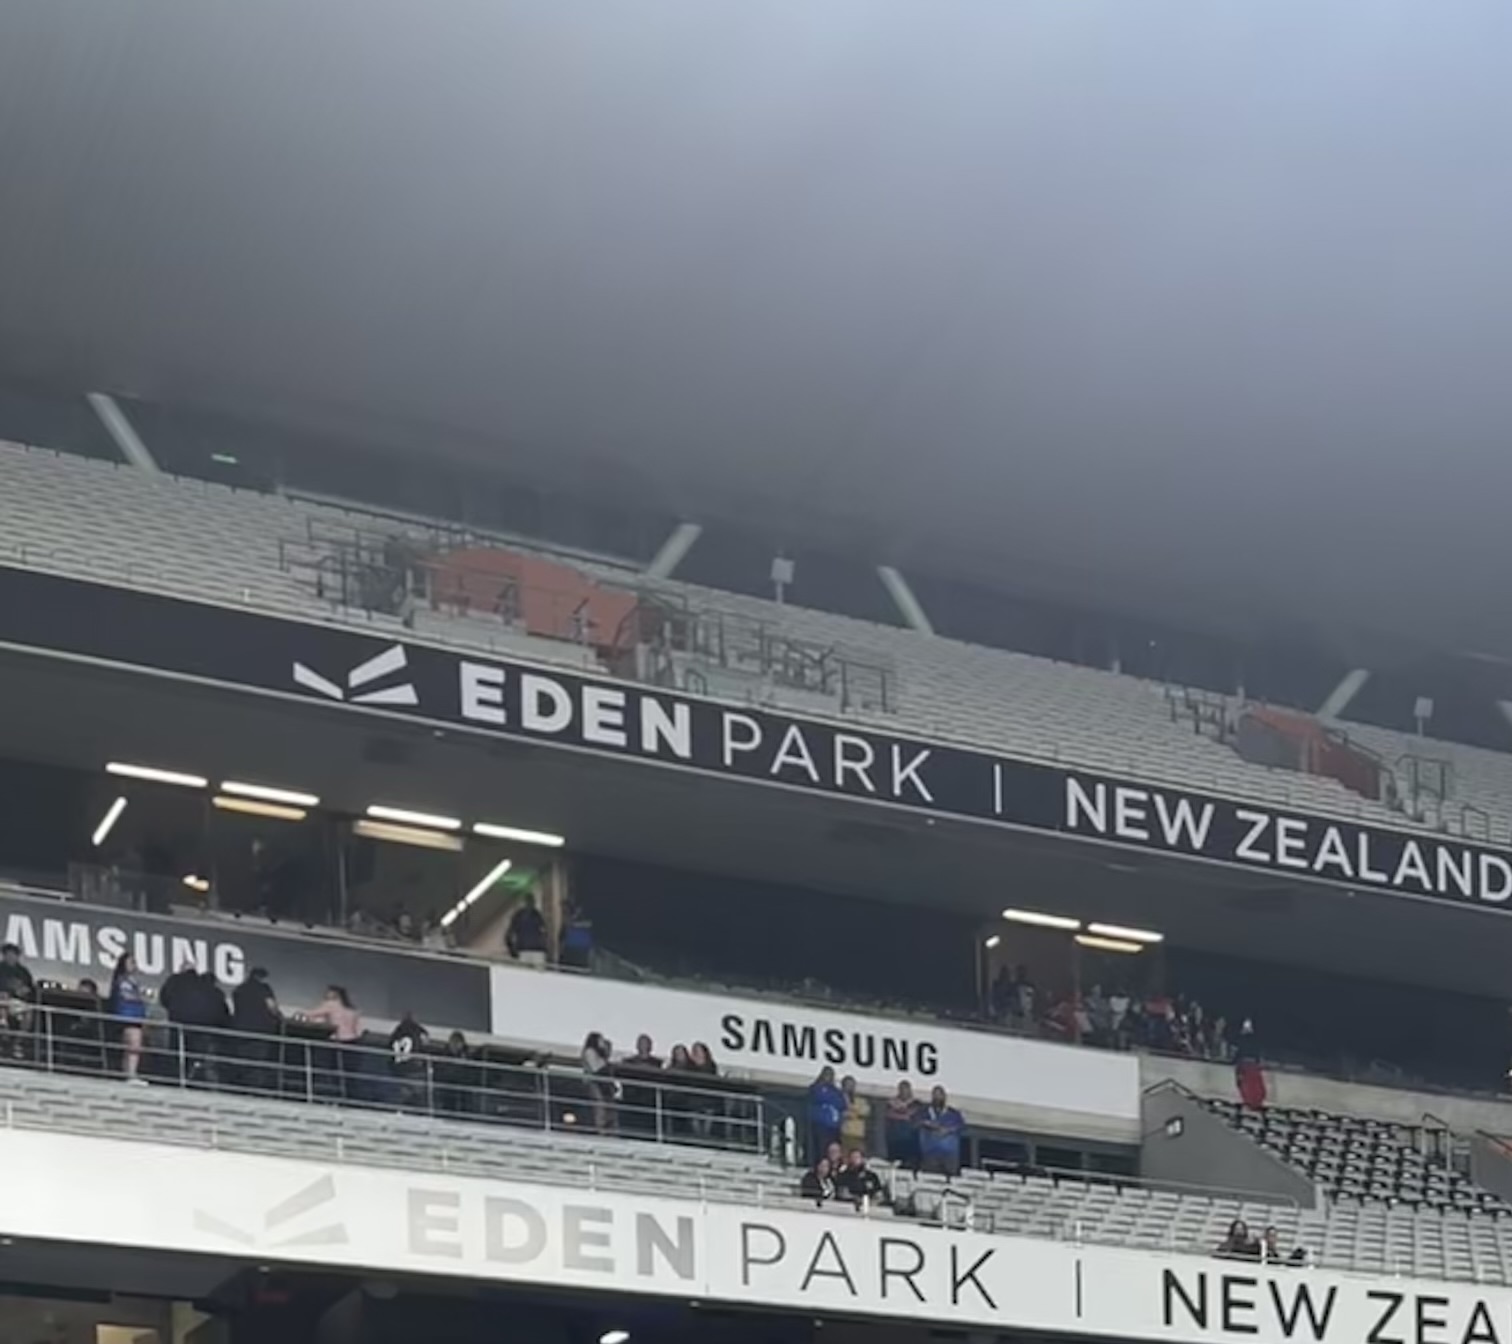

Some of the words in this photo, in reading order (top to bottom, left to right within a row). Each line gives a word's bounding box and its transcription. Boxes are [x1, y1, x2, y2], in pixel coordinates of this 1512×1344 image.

[459, 661, 692, 757] EDEN
[723, 714, 934, 802] PARK
[1066, 777, 1214, 849] NEW
[721, 1013, 938, 1076] SAMSUNG
[408, 1188, 696, 1281] EDEN
[741, 1223, 998, 1309] PARK
[1163, 1269, 1337, 1341] NEW
